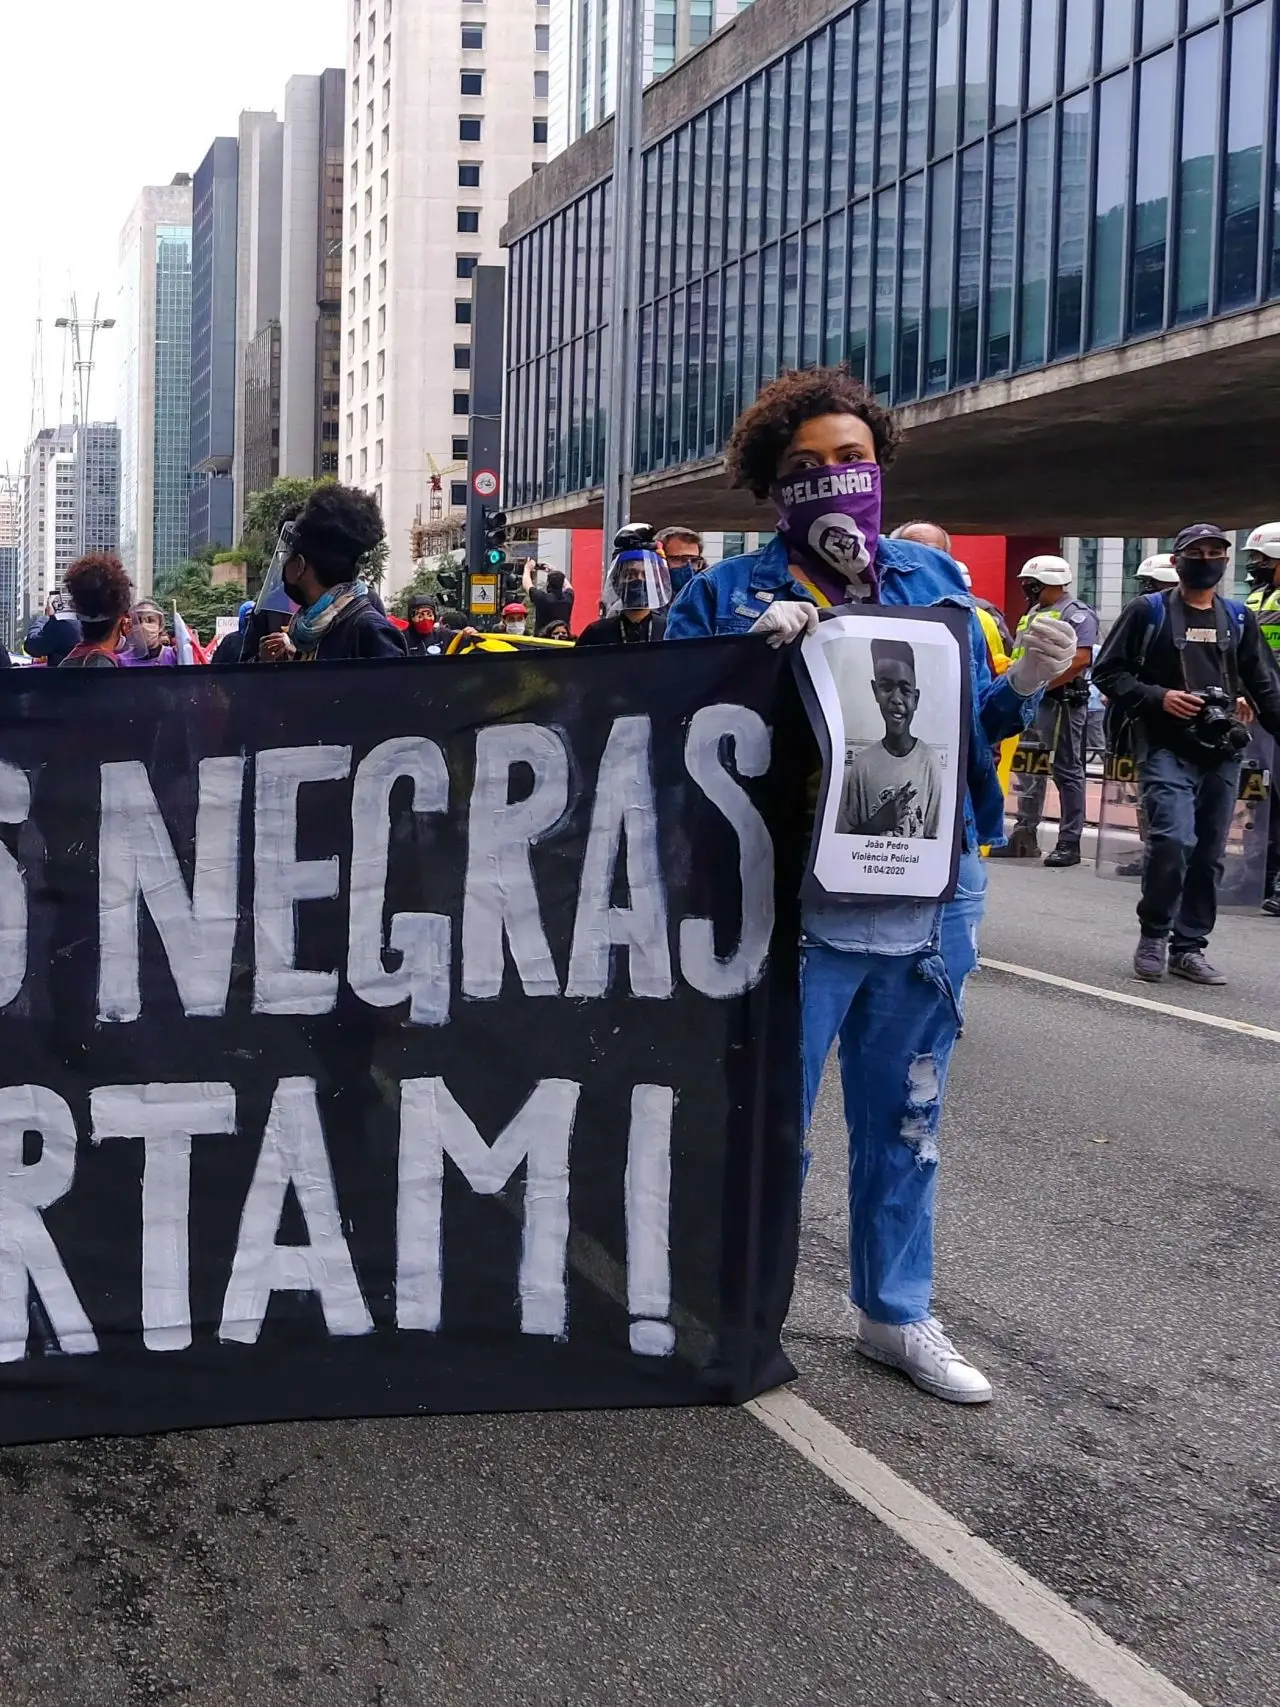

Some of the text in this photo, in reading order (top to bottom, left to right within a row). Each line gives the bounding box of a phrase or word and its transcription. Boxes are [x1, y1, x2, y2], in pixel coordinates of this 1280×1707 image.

[782, 469, 873, 506] #ELENÃO
[1011, 751, 1053, 775] CIA
[865, 840, 909, 850] João Pedro
[96, 703, 775, 1025] NEGRAS
[851, 851, 920, 863] Violência Policial
[863, 865, 905, 875] 18/04/2020
